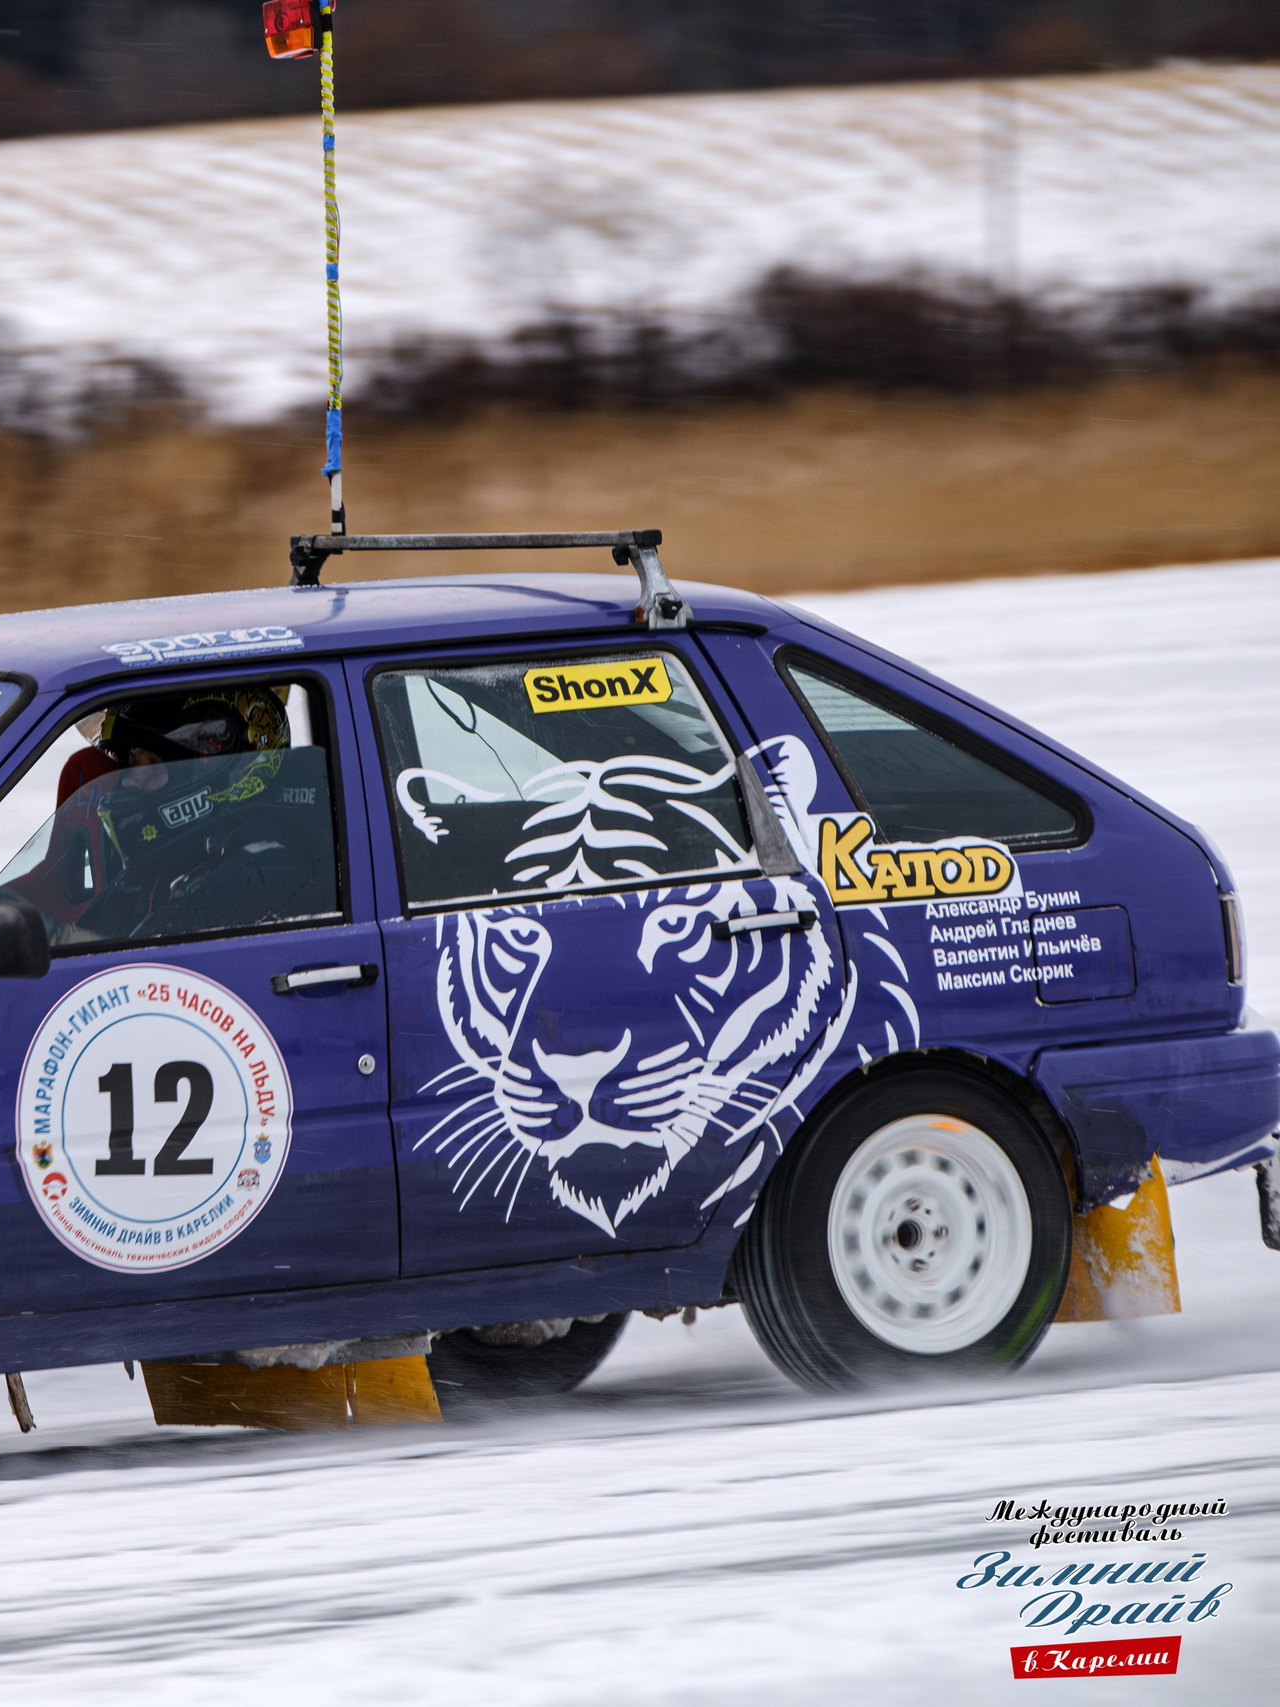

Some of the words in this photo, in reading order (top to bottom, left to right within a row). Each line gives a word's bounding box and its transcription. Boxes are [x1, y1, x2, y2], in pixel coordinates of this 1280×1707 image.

[106, 625, 300, 664] sparco
[533, 665, 660, 703] ShonX
[166, 791, 212, 824] agv
[277, 786, 318, 805] RIDE
[925, 897, 1021, 920] Александр
[1025, 890, 1081, 912] Бунин
[930, 919, 998, 943] Андрей
[1000, 914, 1077, 935] Гладнев
[933, 944, 1020, 967] Валентин
[1023, 934, 1103, 957] Ильичёв
[937, 969, 1006, 991] Максим
[1009, 963, 1075, 985] Скорик
[34, 984, 131, 1135] МАРАФОН-ГИГАНТ
[176, 986, 236, 1034] ЧАСОВ
[231, 1027, 257, 1060] НА
[95, 1060, 215, 1177] 12
[68, 1196, 118, 1240] ЗИМНИЙ
[116, 1227, 162, 1246] ДРАЙВ
[165, 1228, 174, 1244] В
[176, 1193, 236, 1240] КАРЕЛИИ
[223, 1198, 254, 1231] спорта
